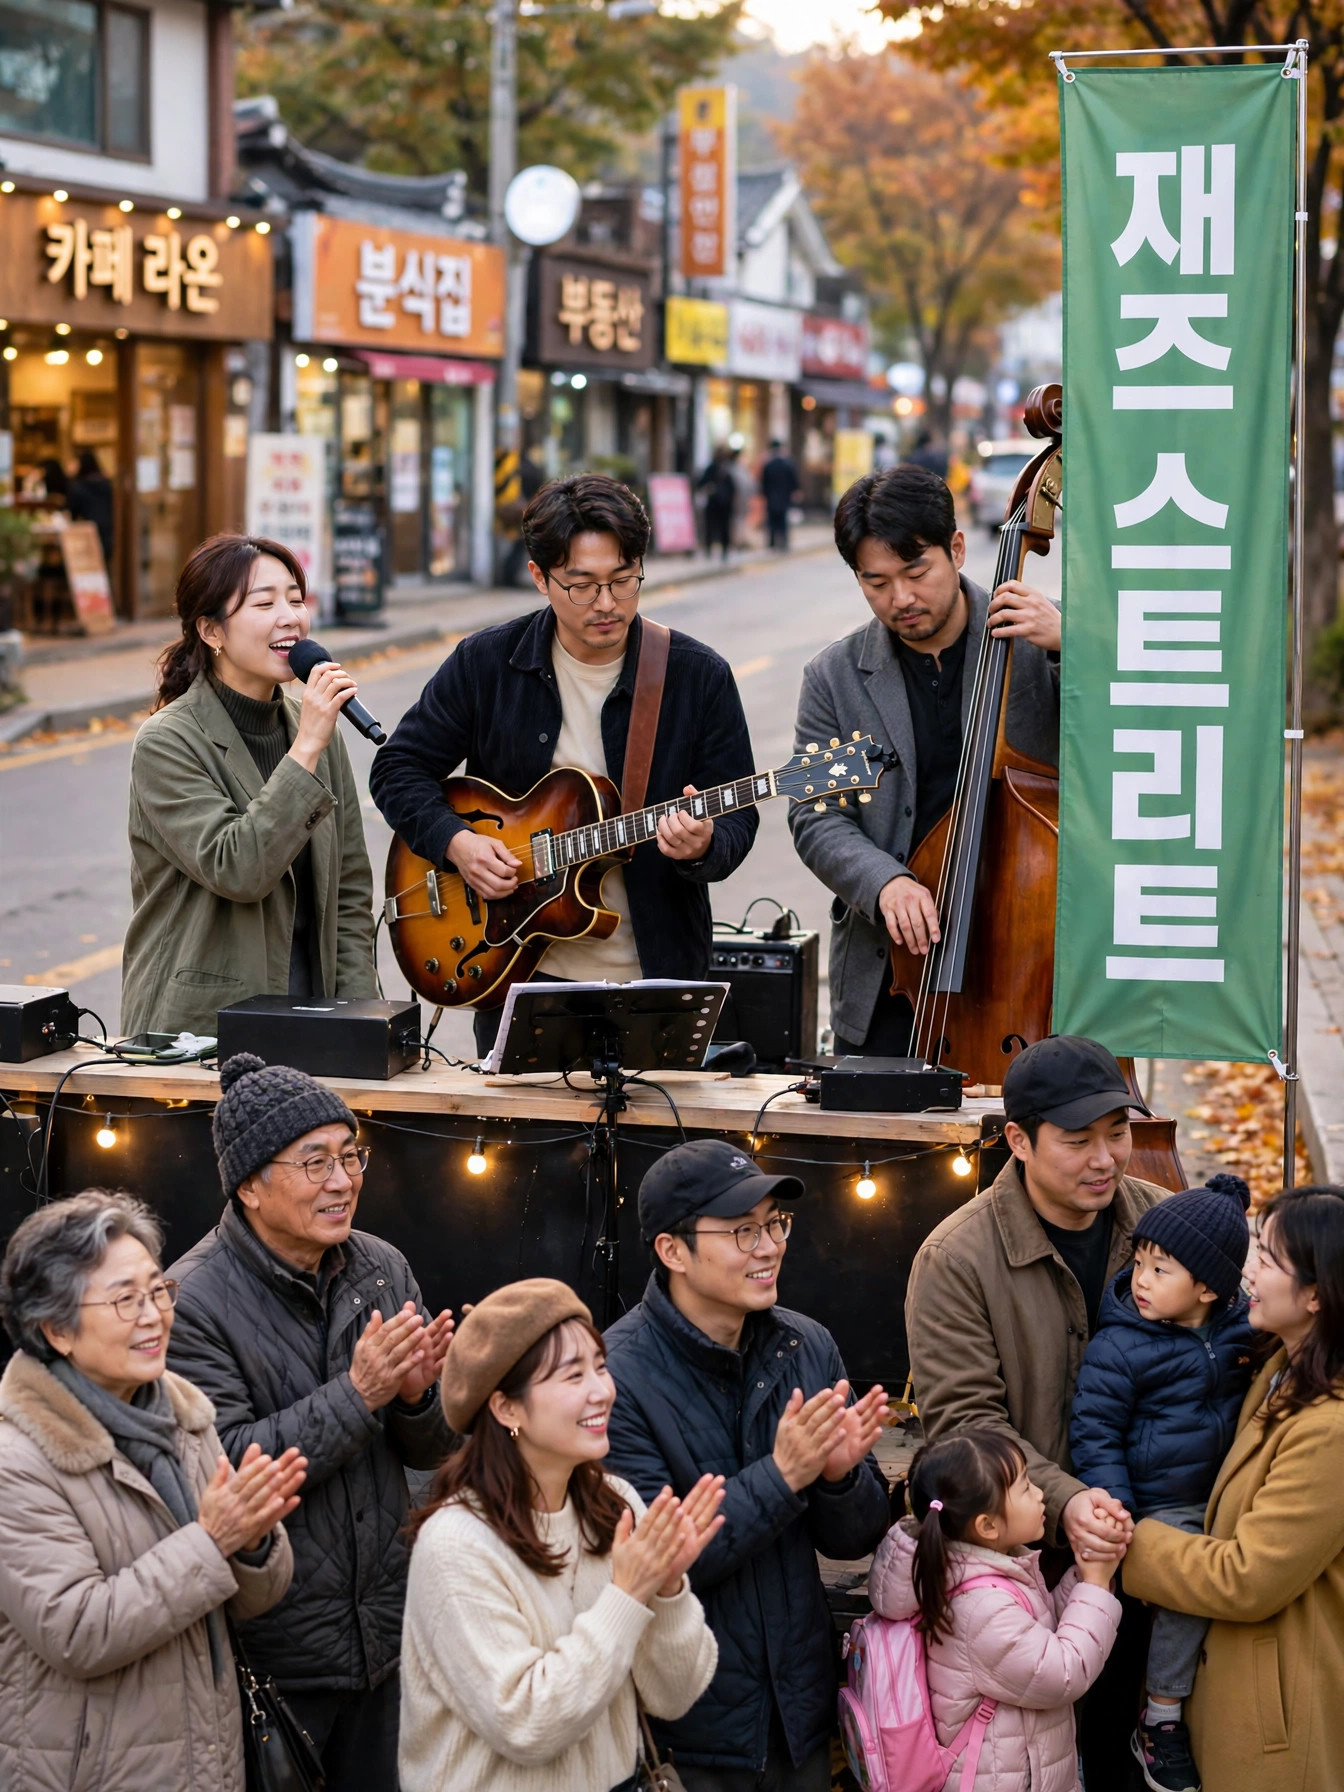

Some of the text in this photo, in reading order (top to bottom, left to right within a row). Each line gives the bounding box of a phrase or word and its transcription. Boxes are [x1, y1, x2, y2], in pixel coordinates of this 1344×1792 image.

[46, 217, 224, 314] 카페 라온
[356, 239, 472, 337] 분식집
[558, 273, 645, 353] 부동산
